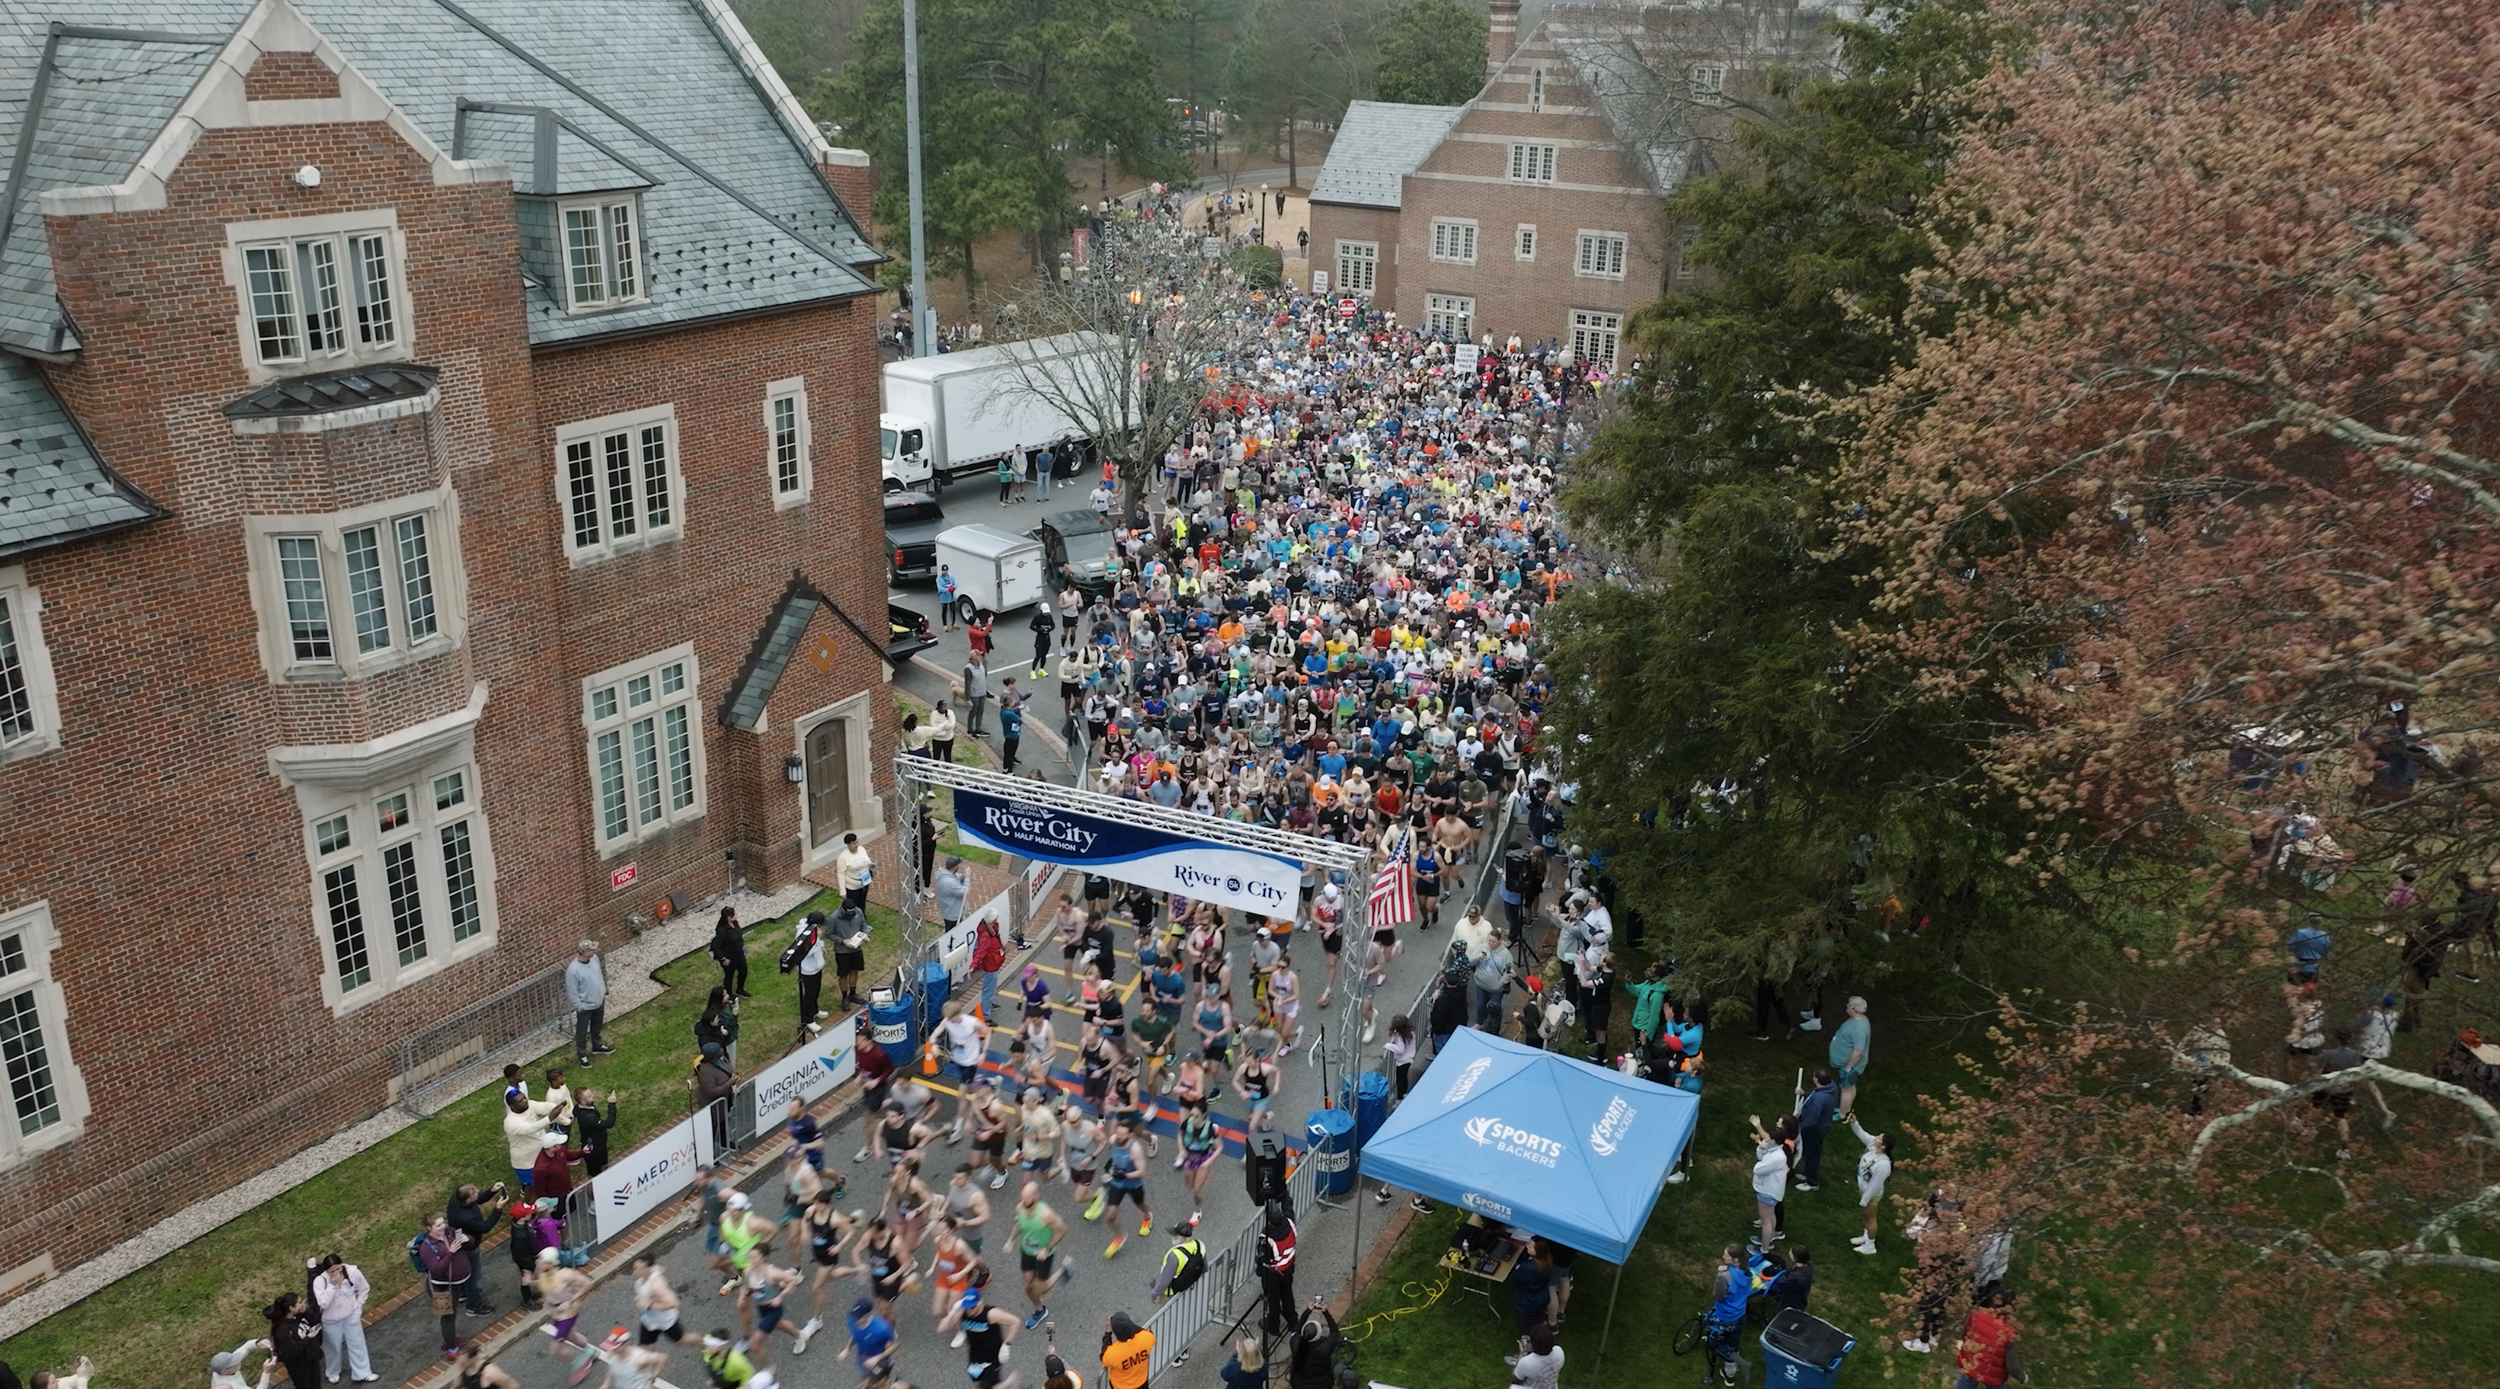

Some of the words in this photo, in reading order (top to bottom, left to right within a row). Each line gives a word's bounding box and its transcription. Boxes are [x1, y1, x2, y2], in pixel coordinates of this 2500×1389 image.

[1008, 801, 1039, 813] VIRGINIA
[984, 806, 1044, 837] River
[1047, 820, 1098, 854] City
[1014, 831, 1034, 843] HALF
[1034, 834, 1077, 852] MARATHON
[617, 870, 633, 884] FDC
[1174, 864, 1221, 888] River
[1247, 880, 1288, 908] City
[875, 1025, 906, 1038] SPORTS
[759, 1060, 819, 1104] VIRGINIA
[759, 1090, 792, 1118] Credit
[794, 1070, 825, 1095] Union
[1597, 1095, 1627, 1138] SPORTS
[1614, 1106, 1637, 1141] BACKERS
[1490, 1123, 1562, 1158] SPORTS
[1497, 1141, 1557, 1168] BACKERS
[637, 1156, 698, 1196] HEALTHCAR
[1475, 1196, 1512, 1216] SPORTS
[1121, 1349, 1148, 1370] EMS
